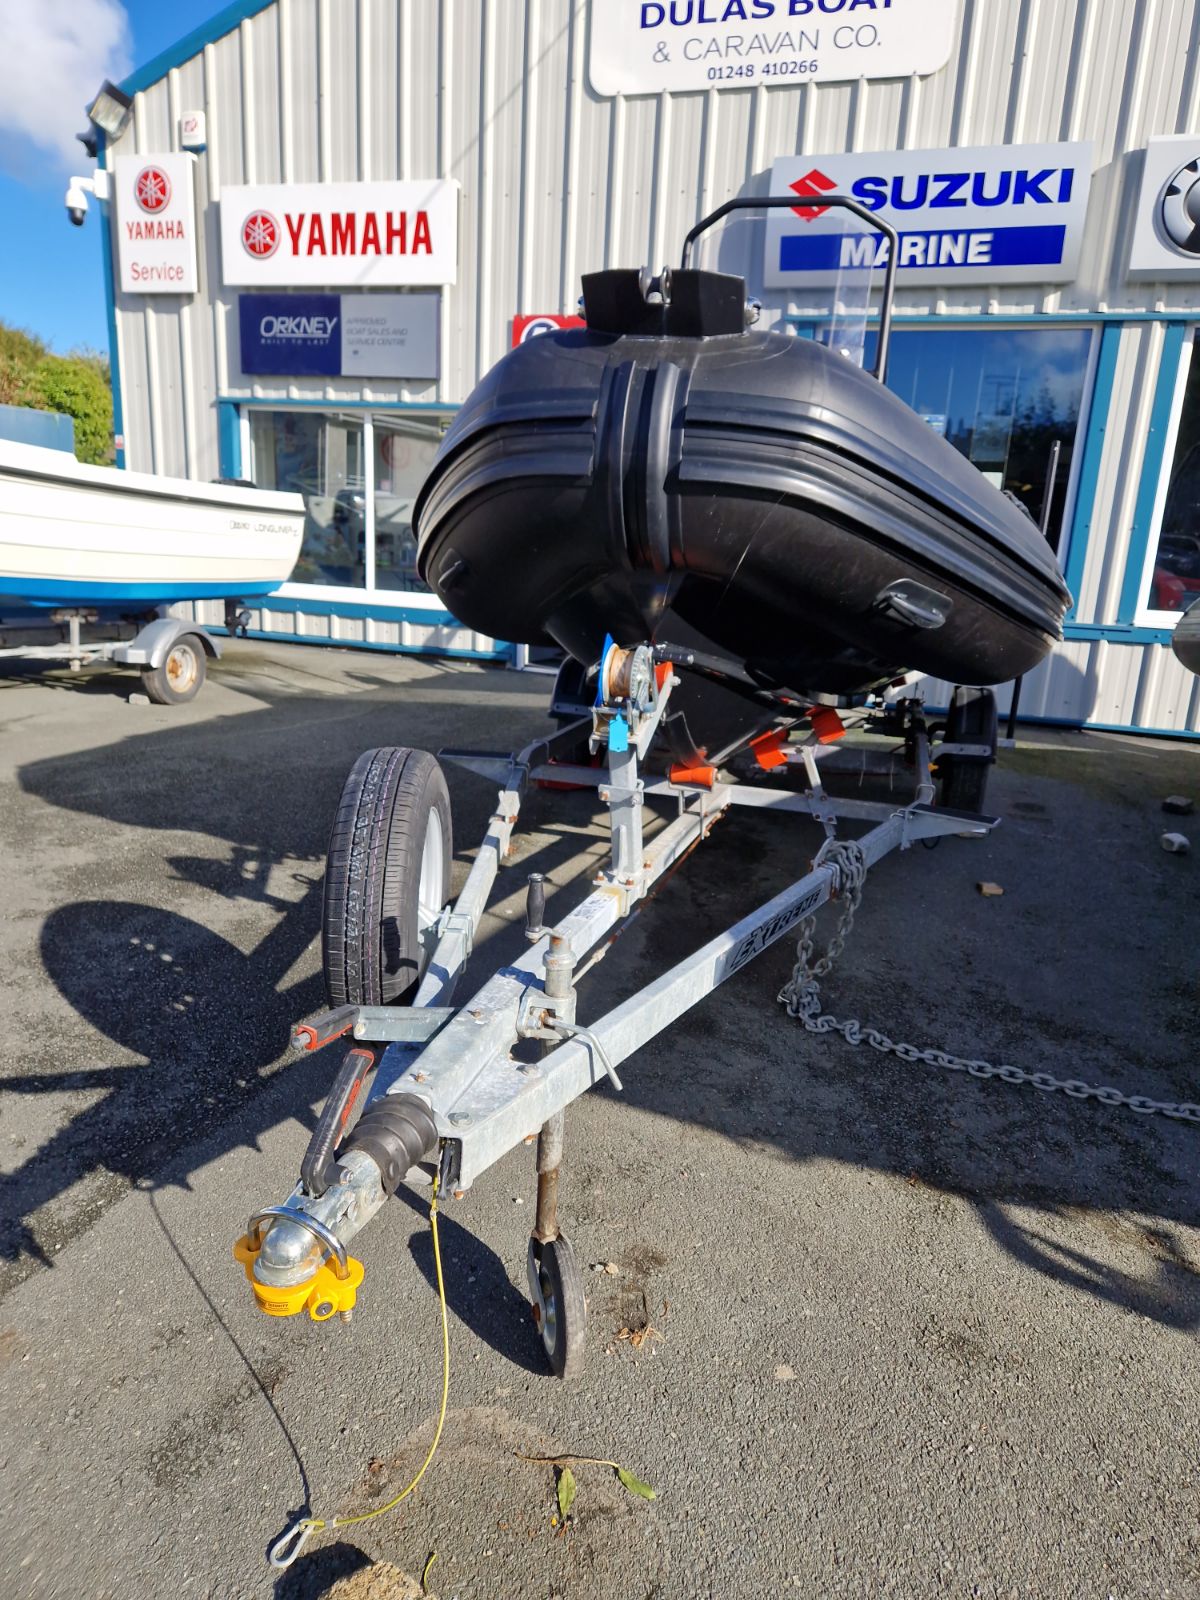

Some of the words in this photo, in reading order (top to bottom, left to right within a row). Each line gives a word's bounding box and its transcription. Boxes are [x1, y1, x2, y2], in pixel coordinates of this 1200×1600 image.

[640, 0, 776, 29] DULAS
[652, 41, 672, 63] &
[683, 29, 820, 62] CARAVAN
[833, 24, 882, 49] CO.
[707, 63, 755, 80] 01248
[761, 59, 819, 77] 410266
[850, 168, 1075, 211] SUZUKI
[126, 220, 185, 240] YAMAHA
[284, 210, 433, 256] YAMAHA
[839, 232, 995, 268] MARINE
[130, 261, 184, 281] Service
[260, 315, 338, 337] ORKNEY
[260, 338, 286, 346] BUILT
[291, 338, 303, 346] TO
